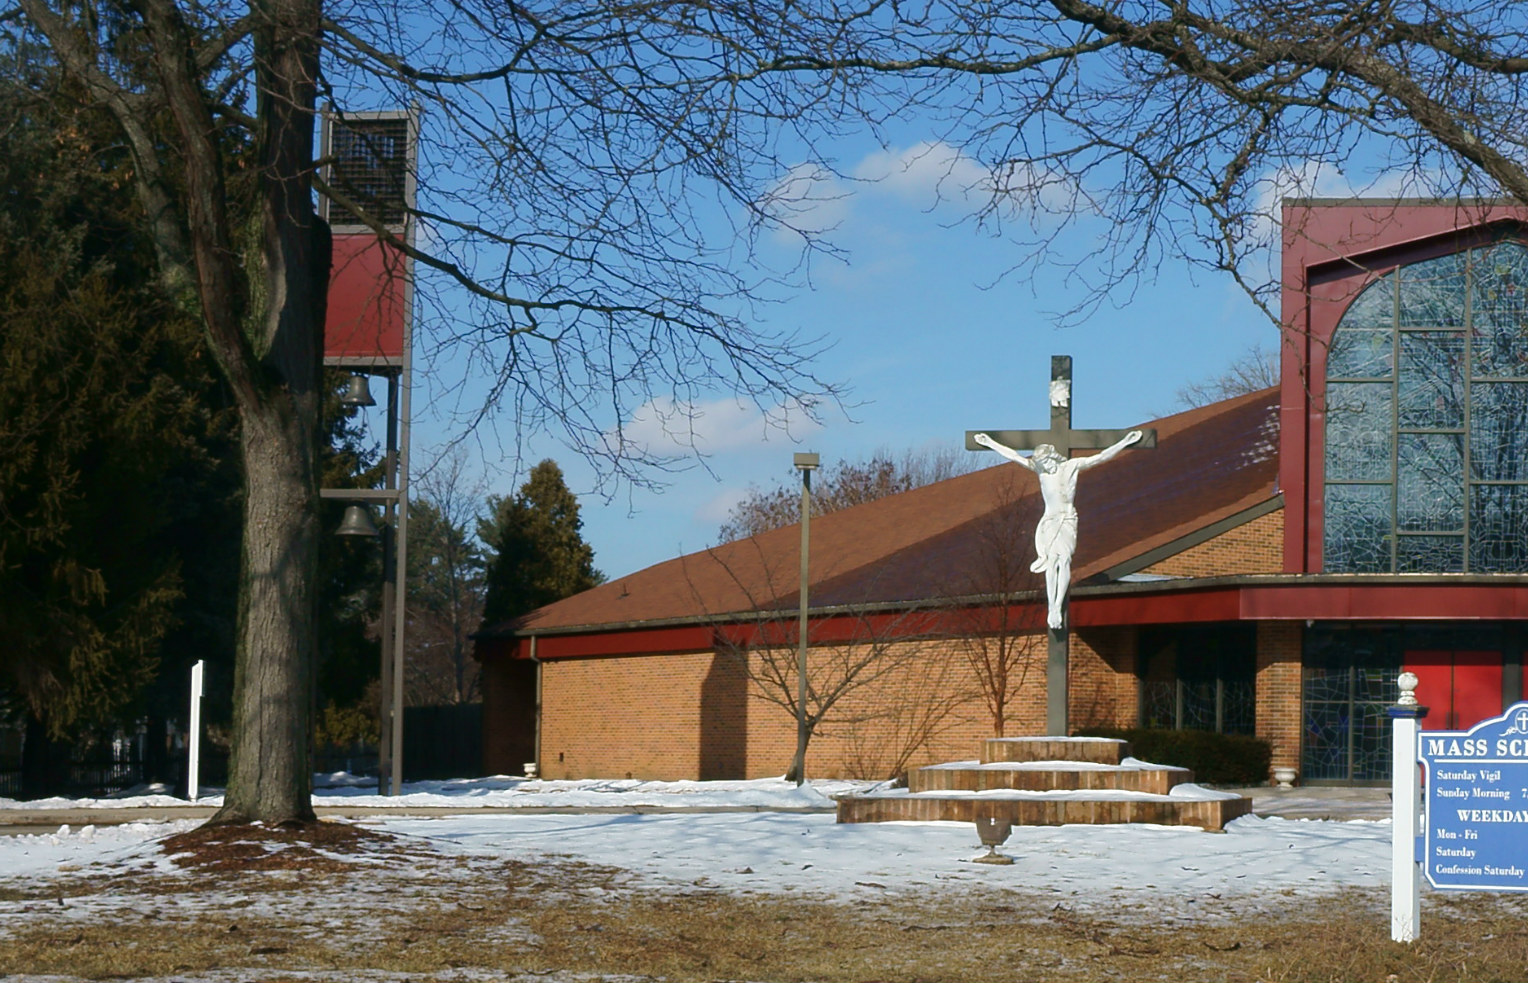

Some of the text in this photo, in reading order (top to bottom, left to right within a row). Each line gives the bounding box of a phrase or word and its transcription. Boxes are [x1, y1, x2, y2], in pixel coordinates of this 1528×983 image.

[1428, 739, 1488, 757] MASS
[1436, 769, 1478, 784] Saturday
[1479, 769, 1501, 784] Vigil
[1436, 786, 1471, 801] Sunday
[1471, 786, 1511, 801] Morning
[1436, 828, 1457, 840] Mon
[1464, 828, 1478, 840] Fri
[1435, 845, 1476, 860] Saturday
[1435, 863, 1483, 877] Confession
[1483, 864, 1525, 879] Saturday
